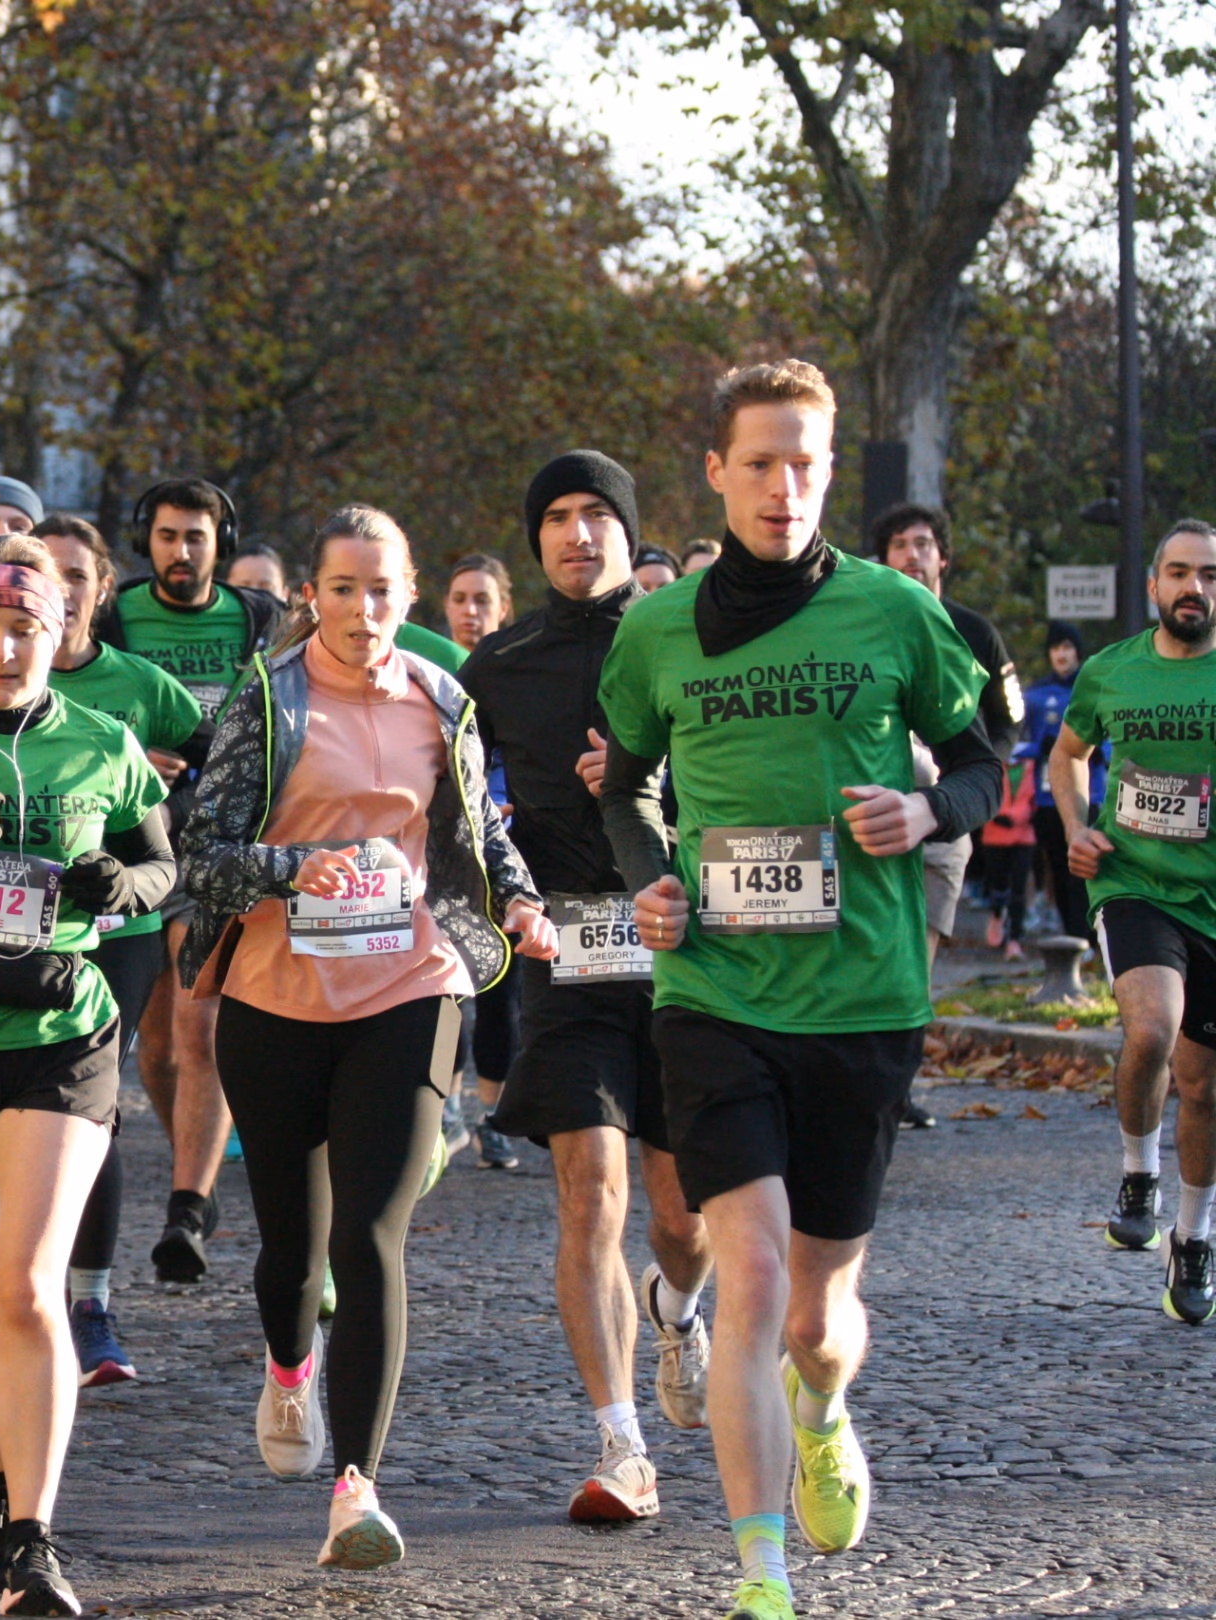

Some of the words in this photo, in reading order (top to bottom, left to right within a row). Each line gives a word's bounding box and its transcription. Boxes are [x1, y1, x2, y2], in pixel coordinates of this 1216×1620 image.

[681, 674, 744, 698] 10KM
[745, 660, 876, 687] ONATERA
[1113, 707, 1153, 722] 10KM
[1155, 702, 1216, 718] ONATE
[1134, 792, 1186, 816] 8922
[359, 845, 387, 856] ATERA
[750, 835, 803, 847] ONATERA
[730, 864, 803, 893] 1438
[824, 876, 835, 899] SAS
[402, 881, 410, 902] SAS
[339, 904, 370, 914] MARIE
[742, 898, 789, 909] JEREMY
[42, 905, 54, 927] SAS
[366, 935, 400, 952] 5352
[588, 951, 636, 962] GREGORY
